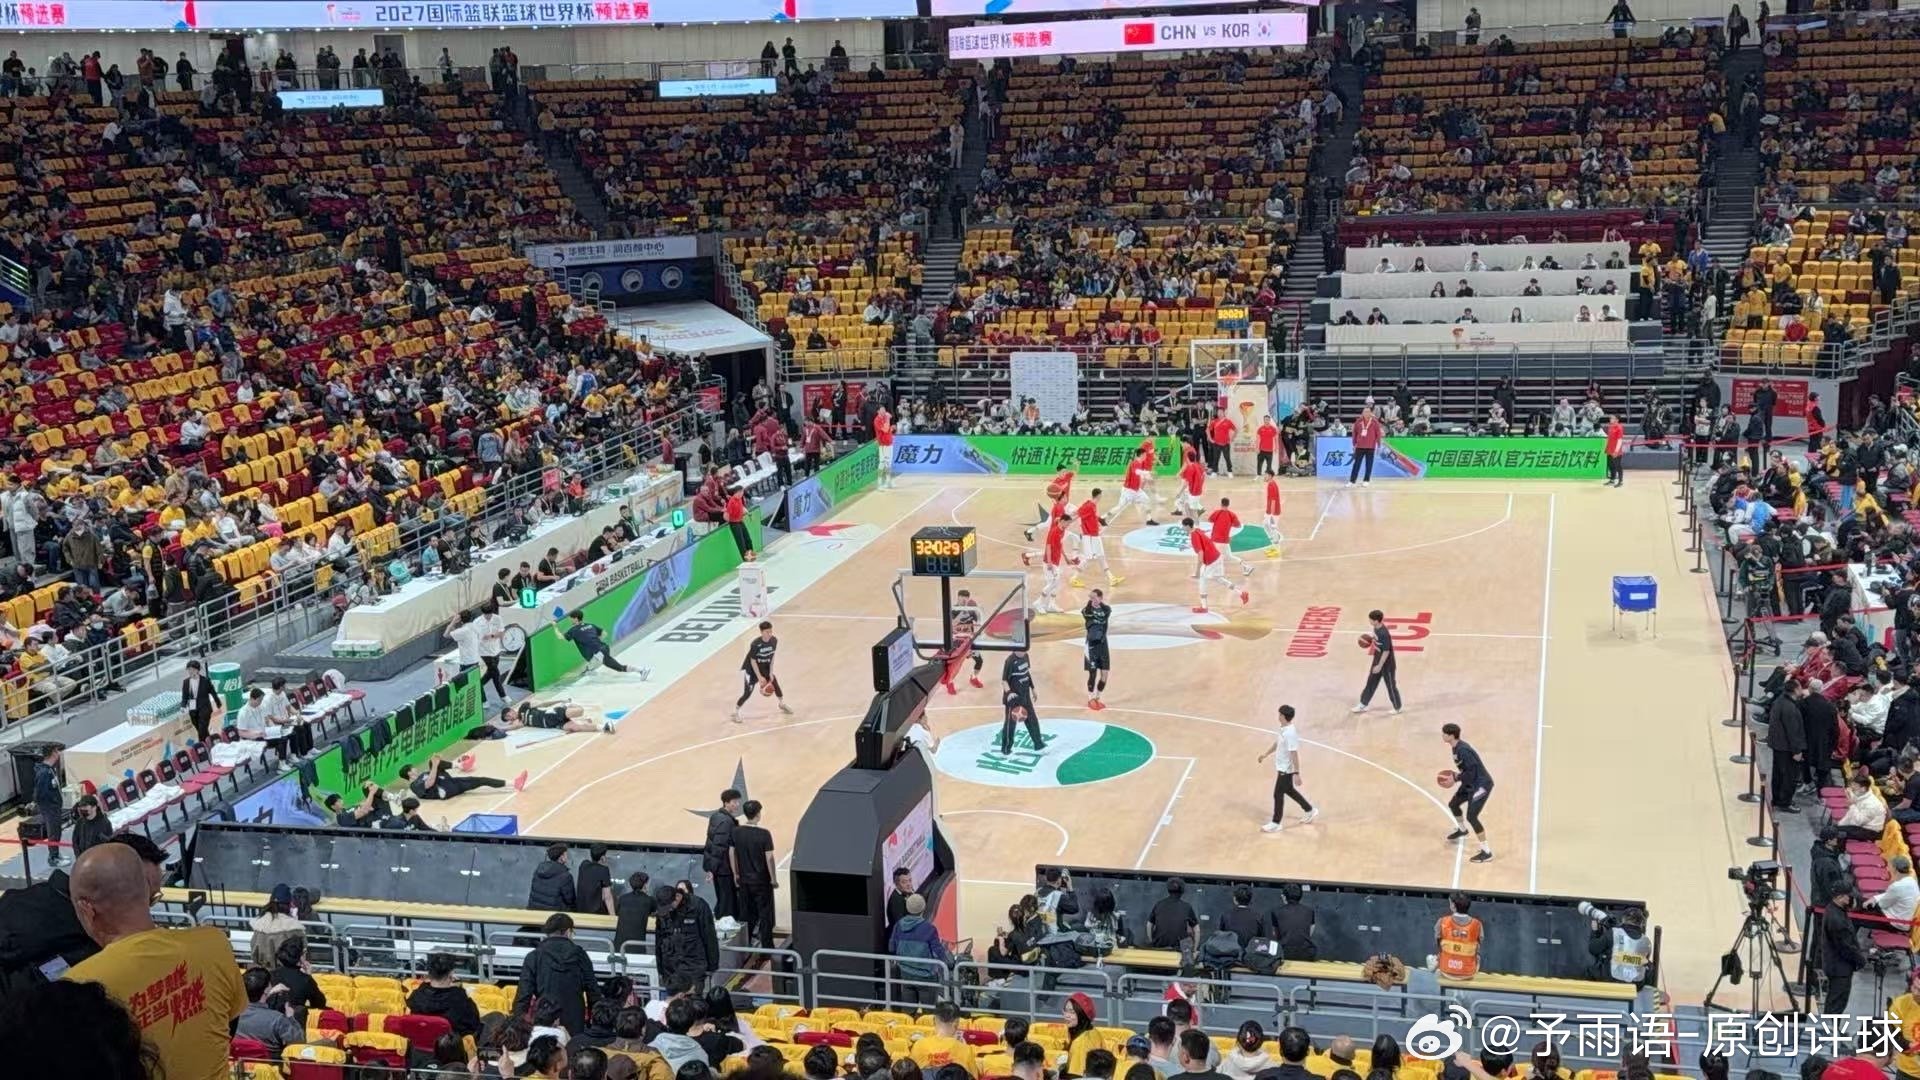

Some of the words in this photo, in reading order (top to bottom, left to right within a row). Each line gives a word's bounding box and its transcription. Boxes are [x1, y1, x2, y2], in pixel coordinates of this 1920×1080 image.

[1161, 25, 1196, 40] CHN
[894, 444, 944, 464] 魔力
[1426, 449, 1601, 470] 中国国家队官方运动饮料
[522, 589, 535, 607] 0
[1286, 606, 1341, 658] QUALIFIERS
